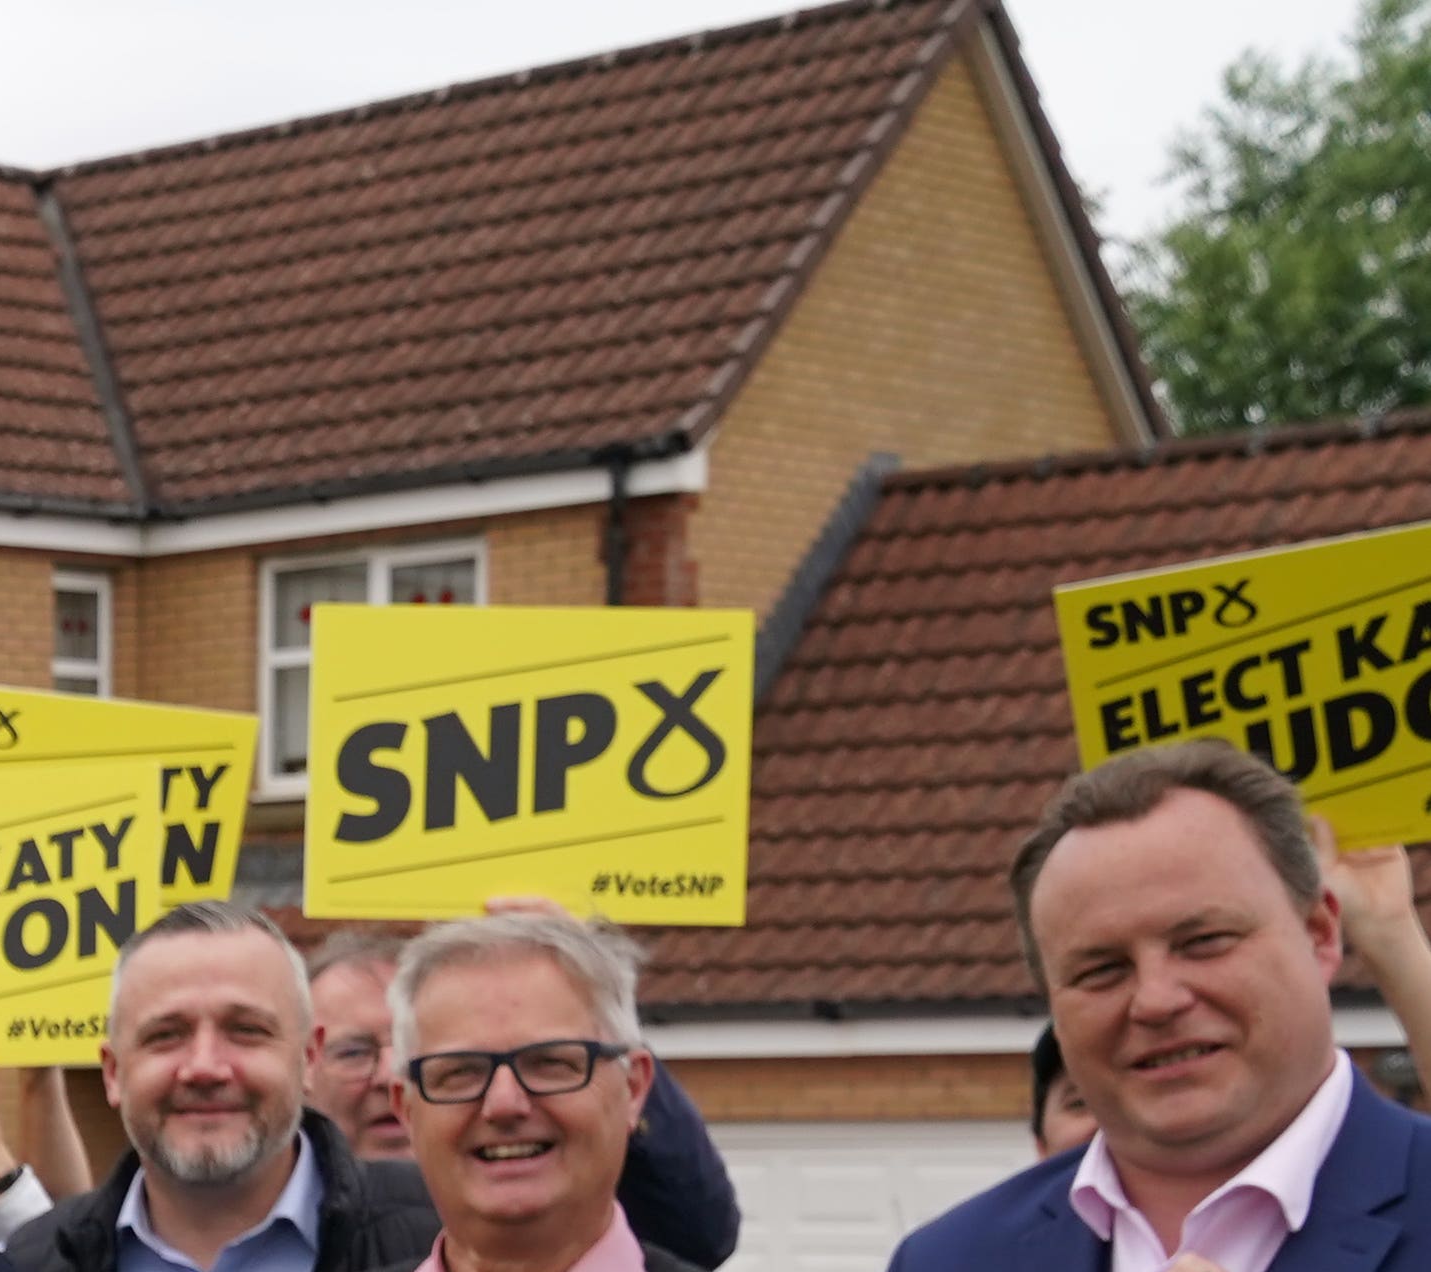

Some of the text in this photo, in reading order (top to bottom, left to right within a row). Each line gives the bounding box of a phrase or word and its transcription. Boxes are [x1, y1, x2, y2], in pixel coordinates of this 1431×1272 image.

[1085, 589, 1205, 649] SNP
[1100, 639, 1311, 753] ELECT
[1336, 600, 1431, 682] KA
[162, 764, 229, 812] TY
[333, 691, 618, 844] SNP
[591, 869, 724, 900] #VoteSNP
[7, 1015, 108, 1040] #VoteS
